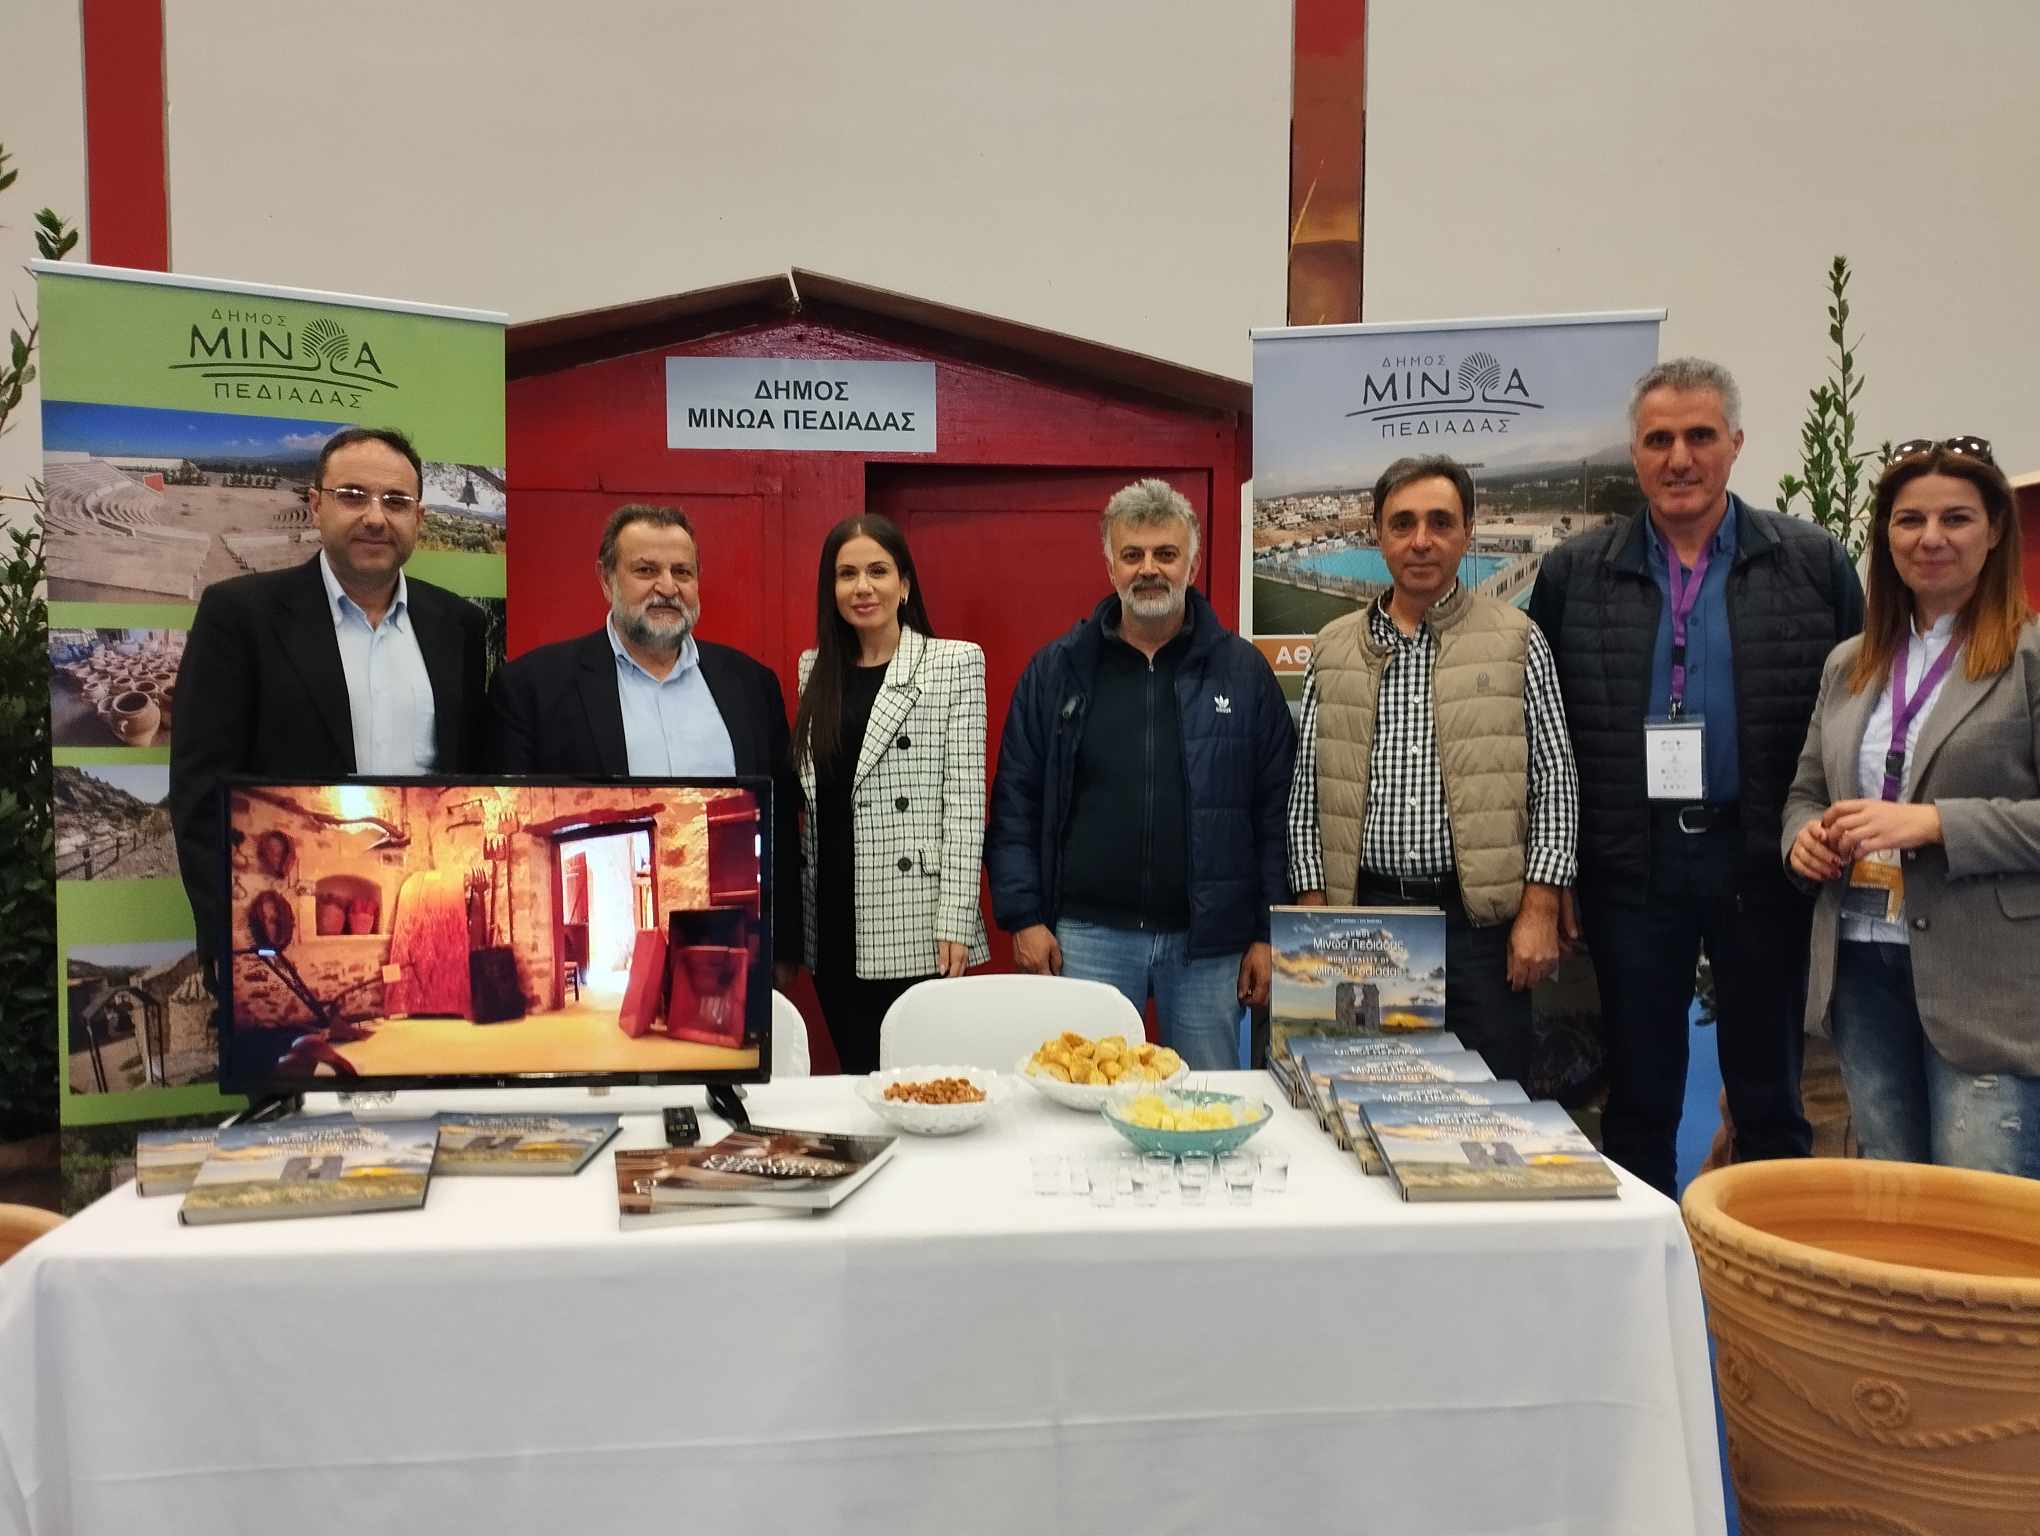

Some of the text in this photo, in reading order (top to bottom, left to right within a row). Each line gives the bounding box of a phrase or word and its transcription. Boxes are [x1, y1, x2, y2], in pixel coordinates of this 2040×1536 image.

[210, 308, 289, 327] ΔΗΜΟΣ
[1381, 354, 1448, 368] ΔΗΜΟΣ
[214, 382, 362, 409] ΠΕΔΙΑΔΑΣ
[754, 379, 849, 401] ΔΗΜΟΣ
[688, 407, 916, 432] ΜΙΝΩΑ ΠΕΔΙΑΔΑΣ
[1381, 418, 1511, 439] ΠΕΔΙΑΔΑΣ
[1275, 645, 1312, 664] ΑΘ
